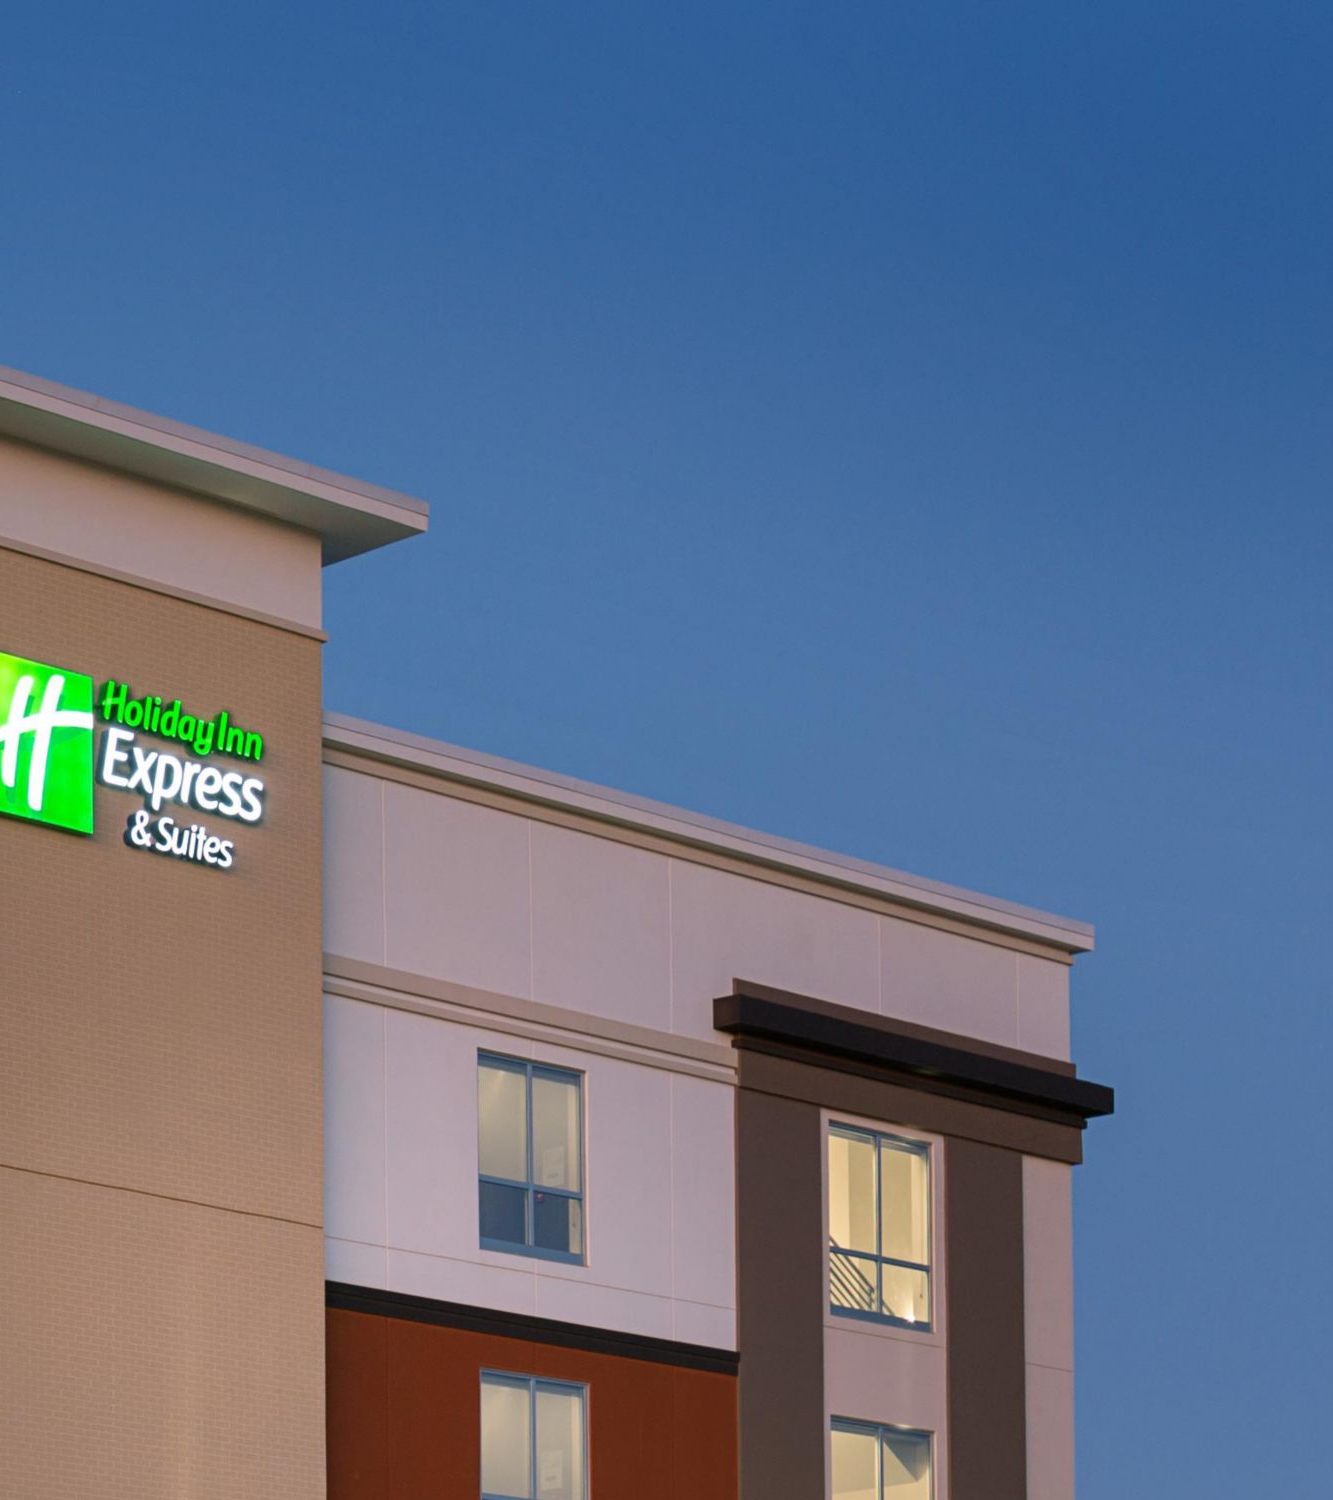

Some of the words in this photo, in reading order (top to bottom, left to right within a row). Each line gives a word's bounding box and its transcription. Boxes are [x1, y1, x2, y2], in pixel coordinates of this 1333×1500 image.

[101, 680, 214, 755] Holiday
[218, 711, 263, 760] Inn
[102, 727, 264, 822] Express
[131, 810, 152, 847] &
[156, 816, 234, 868] Suites
